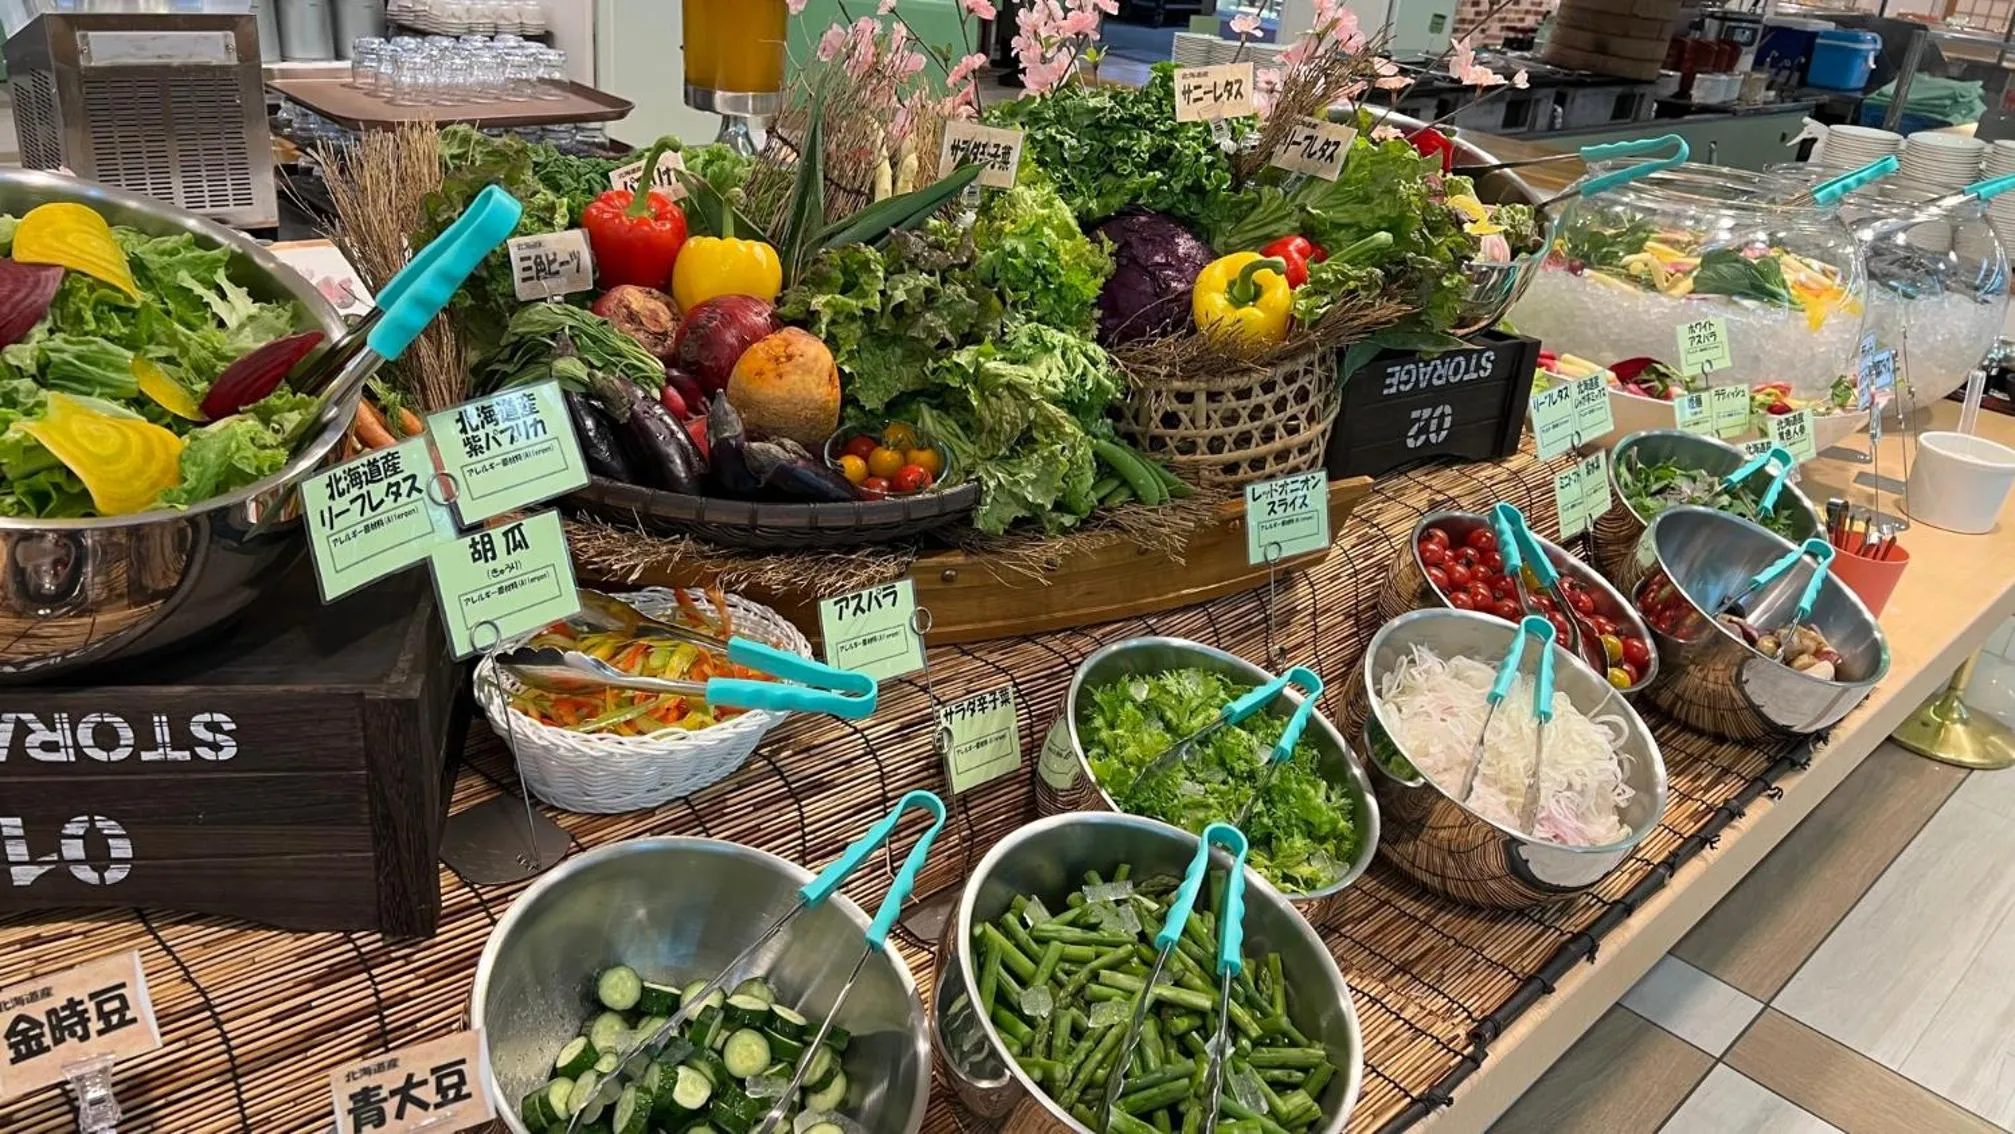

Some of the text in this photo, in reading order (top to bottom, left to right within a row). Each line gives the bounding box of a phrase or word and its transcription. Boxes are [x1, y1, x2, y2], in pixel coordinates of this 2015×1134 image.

[1182, 79, 1244, 105] サニーレタス
[1283, 129, 1341, 164] リーフレタス
[1688, 320, 1714, 335] ホワイト
[1688, 331, 1717, 346] アスパラ
[1383, 350, 1495, 395] STORAGE
[1533, 386, 1570, 412] リーフレタス
[1714, 387, 1746, 400] ラディッシュ
[456, 393, 540, 434] 北海道産
[1406, 404, 1452, 448] 02
[462, 418, 547, 458] 紫パプリカ
[326, 451, 404, 501] 北海道産
[1252, 475, 1321, 501] レッドオニオン
[320, 474, 423, 531] リーフレタス
[1267, 494, 1308, 516] スライス
[468, 522, 530, 564] 胡瓜
[834, 584, 897, 621] アスパラ
[0, 815, 133, 886] 01
[4, 981, 138, 1066] 金時豆
[345, 1057, 400, 1083] 北海道産
[347, 1057, 472, 1134] 青大豆
